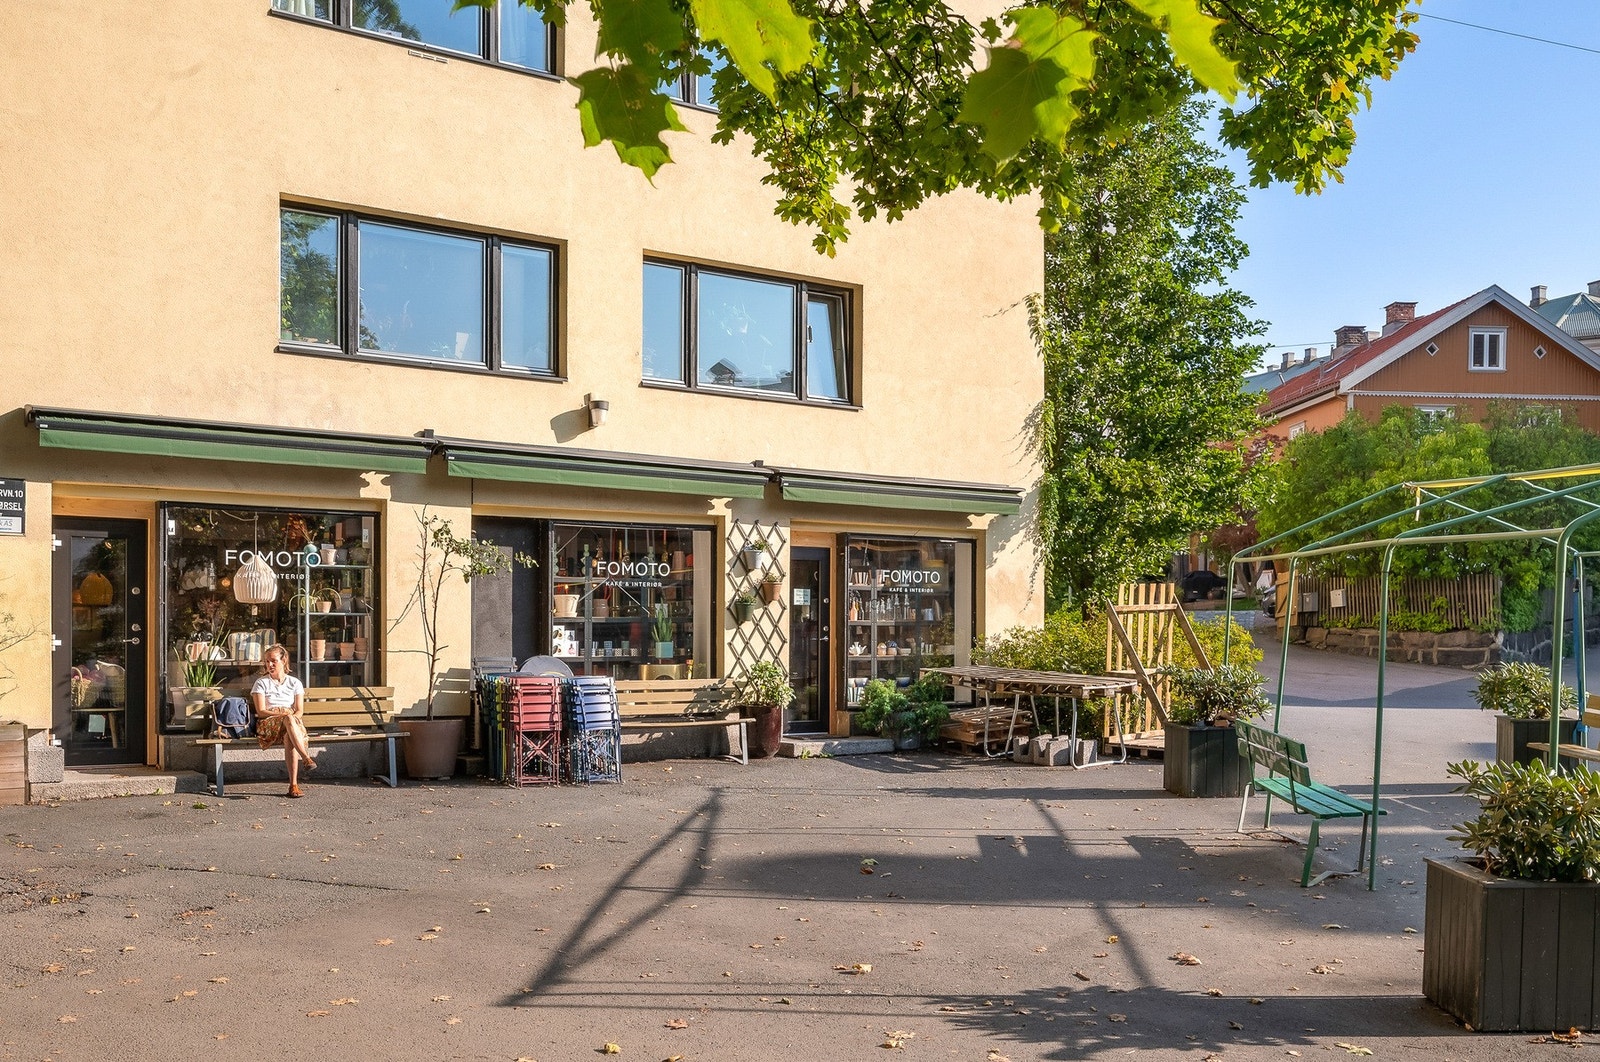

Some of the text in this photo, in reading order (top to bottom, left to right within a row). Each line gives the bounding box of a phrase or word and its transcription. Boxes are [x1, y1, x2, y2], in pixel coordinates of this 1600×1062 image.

[225, 549, 321, 568] FOMOTO
[597, 561, 671, 577] FOMOTO
[882, 569, 941, 584] FOMOTO
